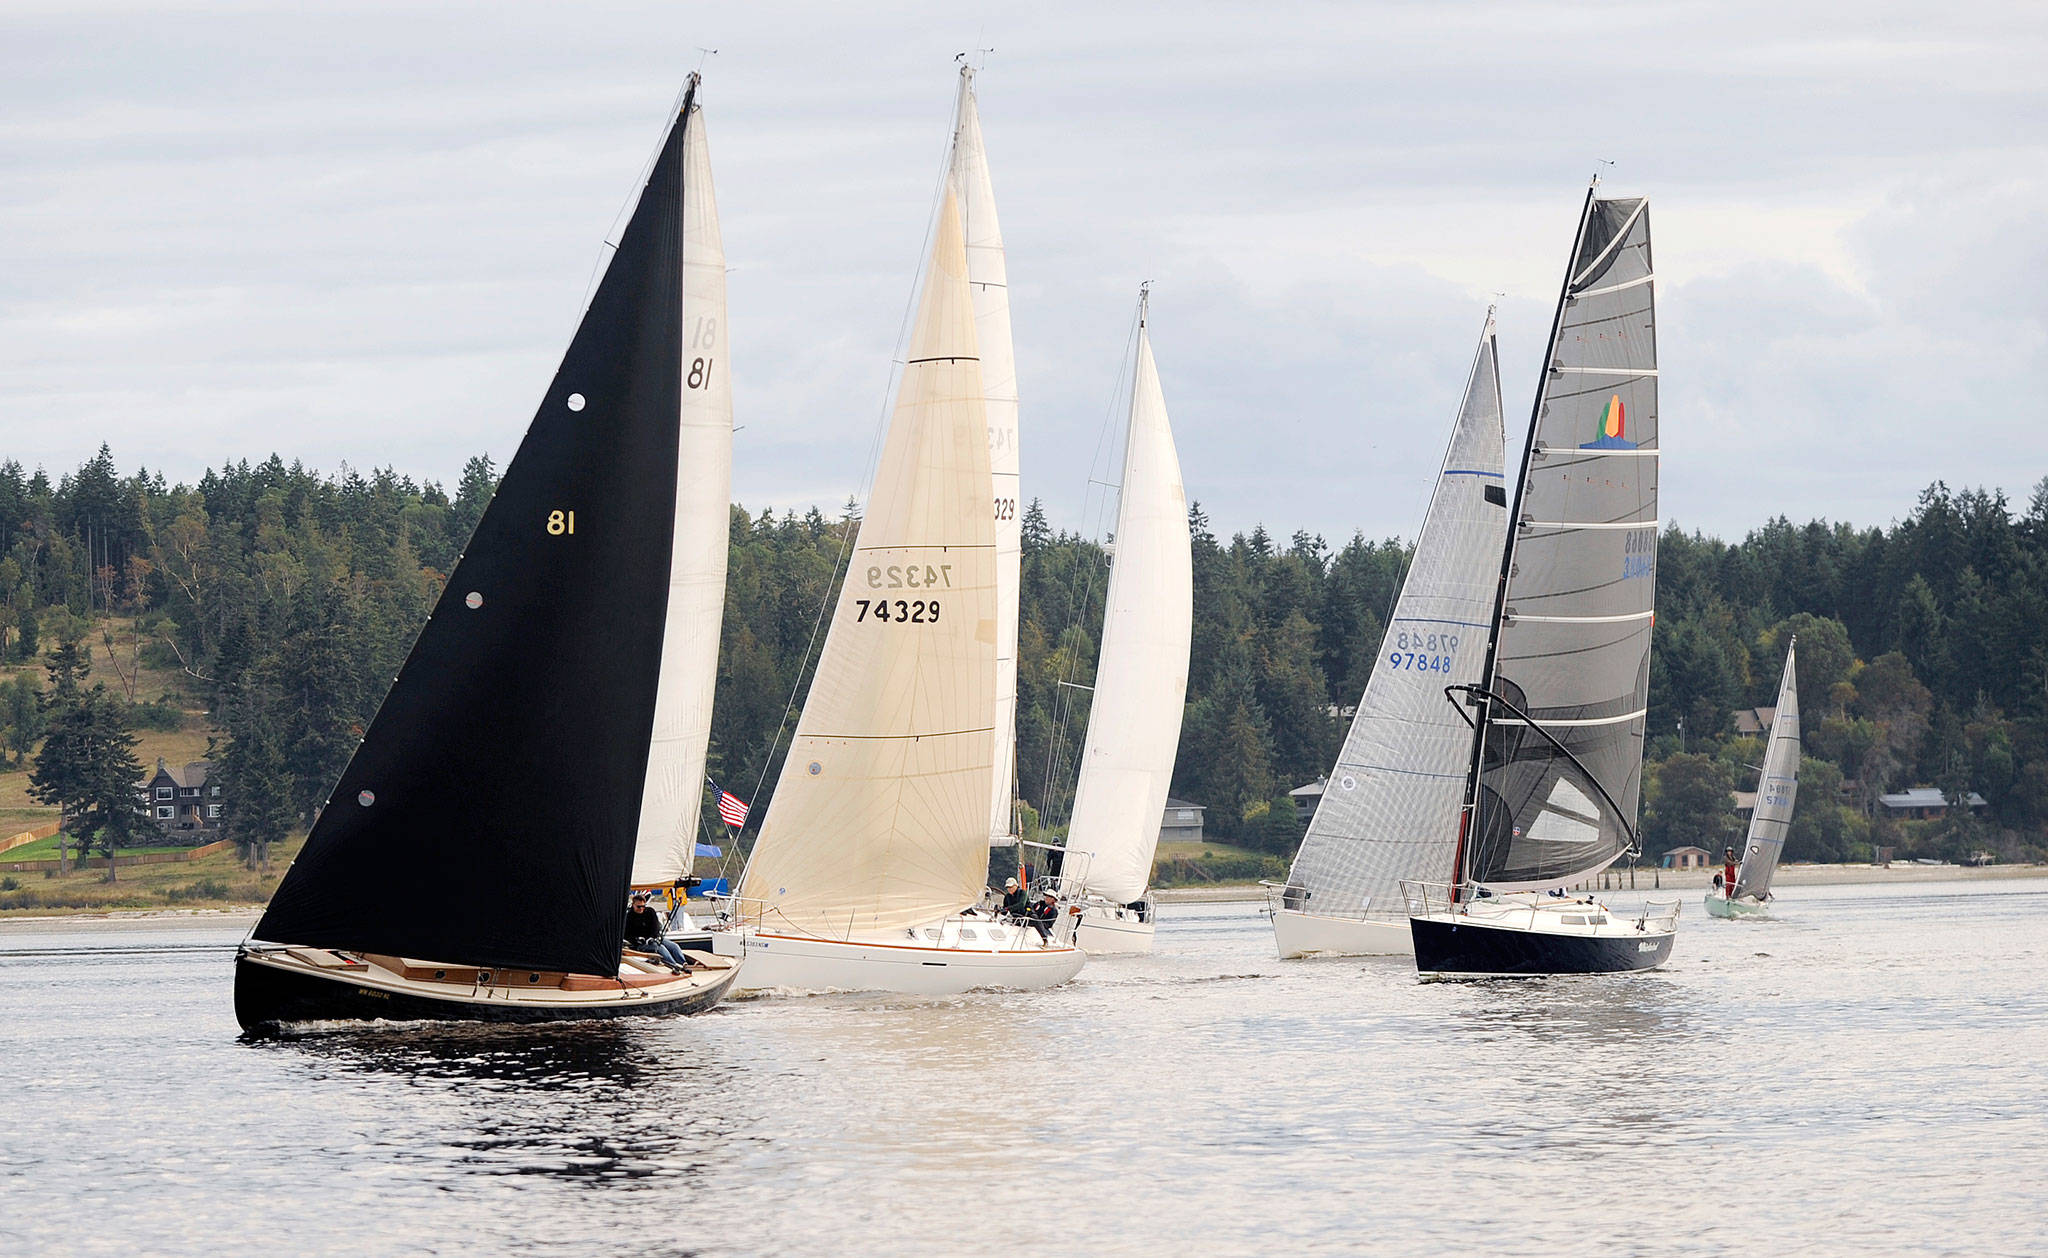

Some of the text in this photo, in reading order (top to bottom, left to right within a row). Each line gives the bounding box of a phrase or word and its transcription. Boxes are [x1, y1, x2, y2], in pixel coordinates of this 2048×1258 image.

[688, 357, 713, 390] 81
[994, 498, 1015, 520] 329
[546, 510, 575, 536] 81
[856, 600, 941, 624] 74329
[1390, 652, 1451, 673] 97848
